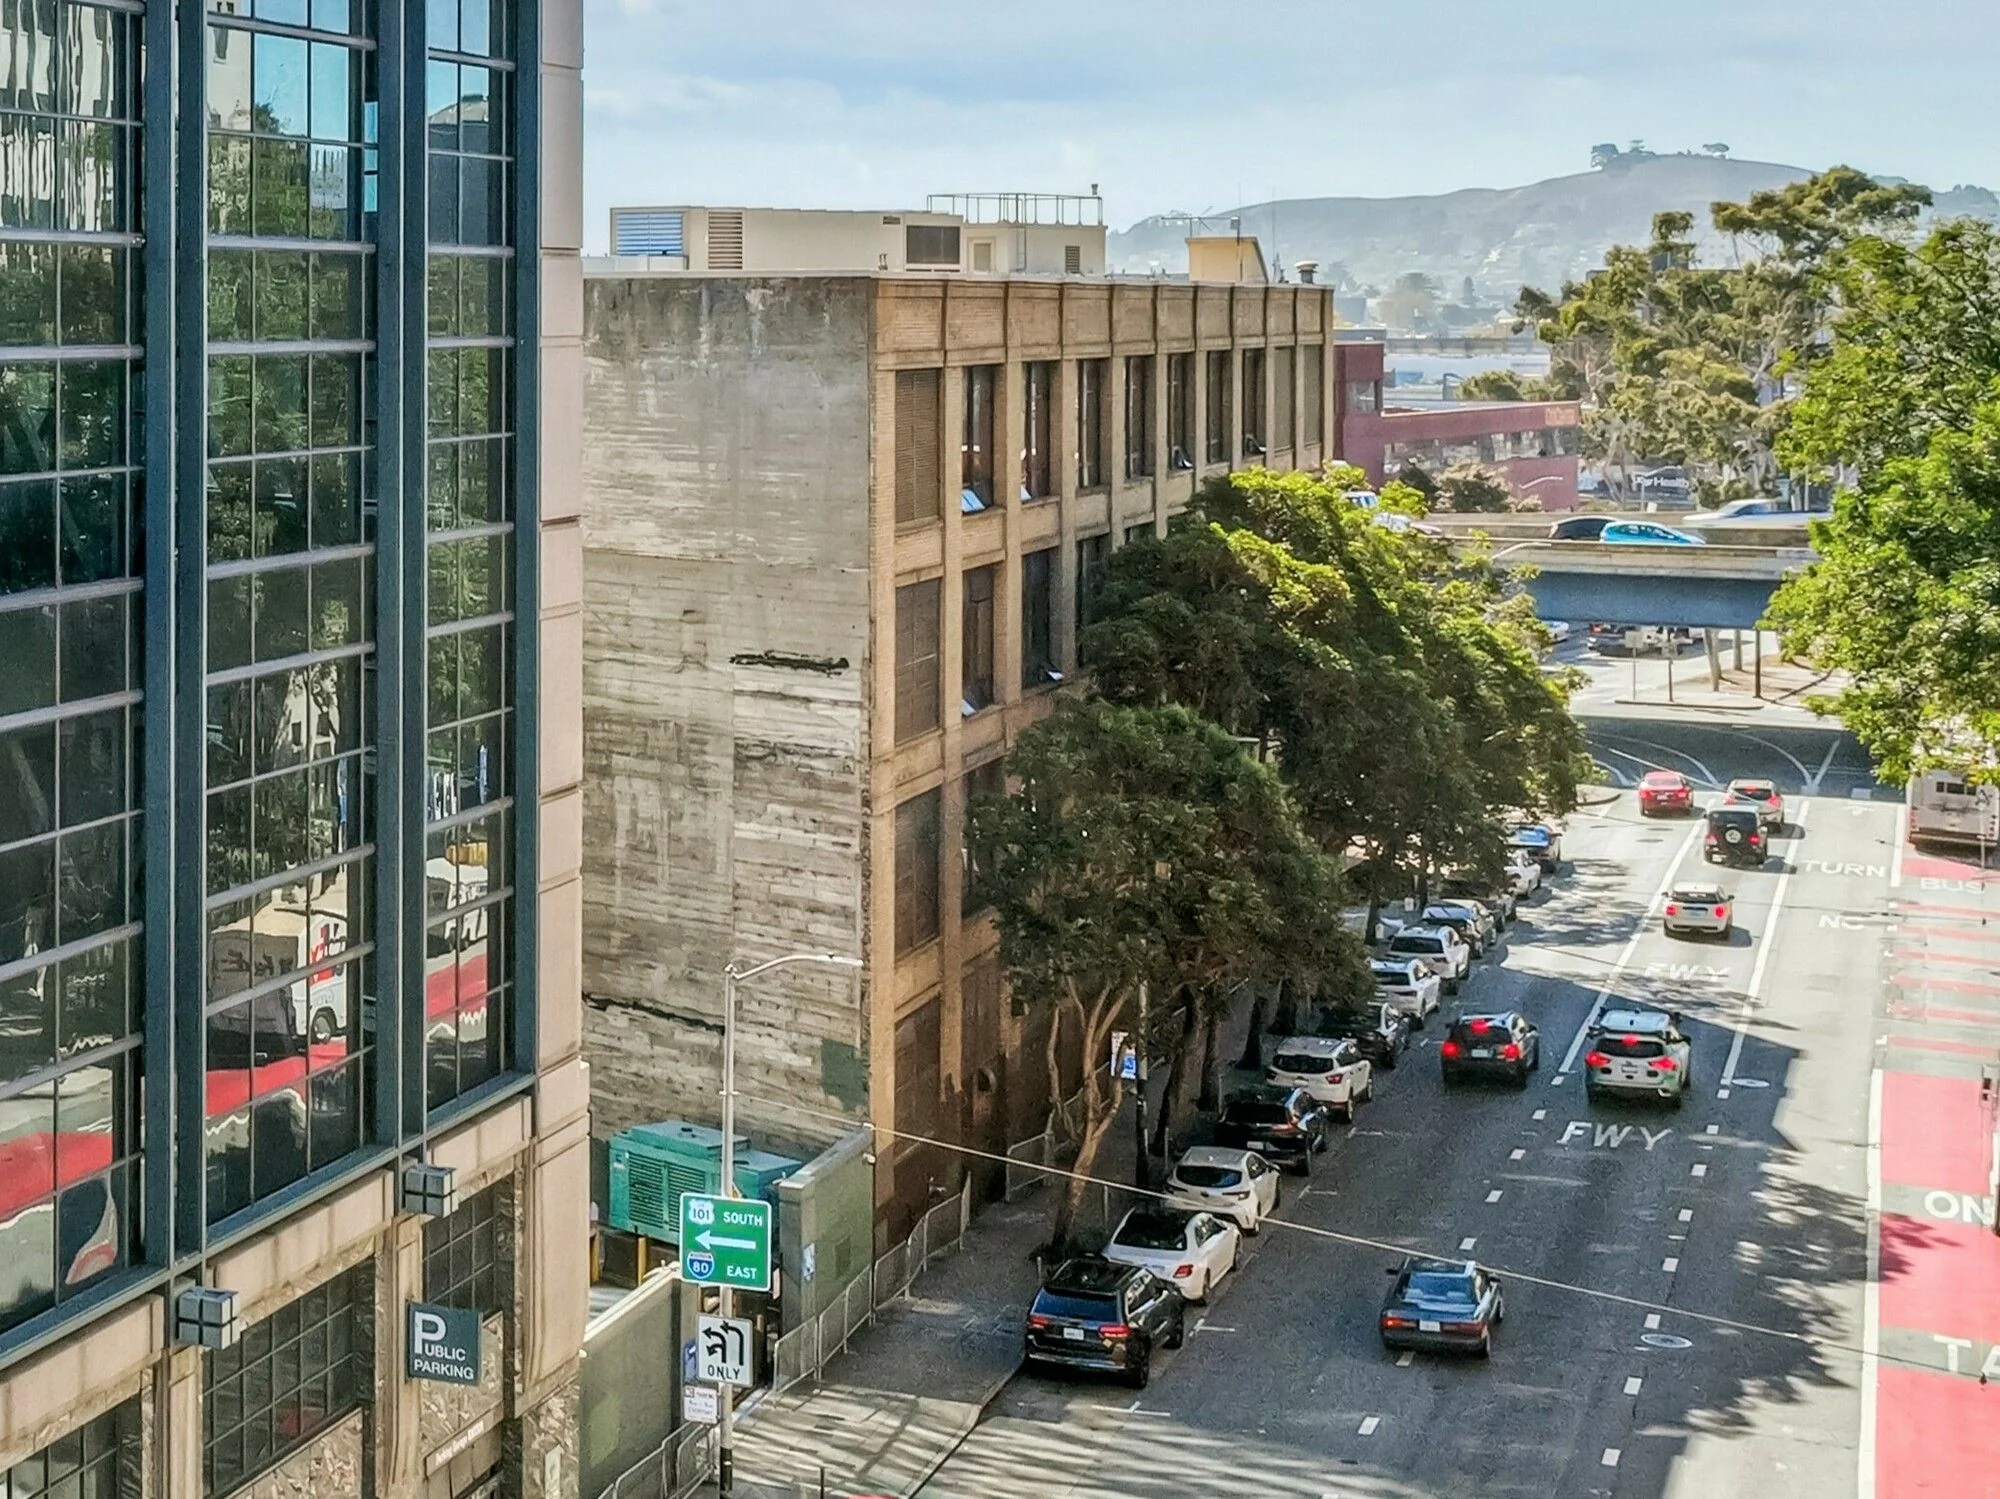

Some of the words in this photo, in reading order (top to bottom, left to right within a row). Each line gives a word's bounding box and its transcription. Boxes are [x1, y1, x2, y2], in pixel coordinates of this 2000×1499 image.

[1800, 859, 1885, 878] TURN
[1920, 877, 1985, 895] BUS
[1556, 1120, 1674, 1151] FWY
[693, 1207, 710, 1220] 101
[723, 1211, 763, 1226] SOUTH
[692, 1263, 709, 1274] 80
[726, 1265, 758, 1280] EAST
[414, 1311, 466, 1361] PUBLIC
[414, 1358, 475, 1380] PARKING
[707, 1364, 741, 1380] ONLY
